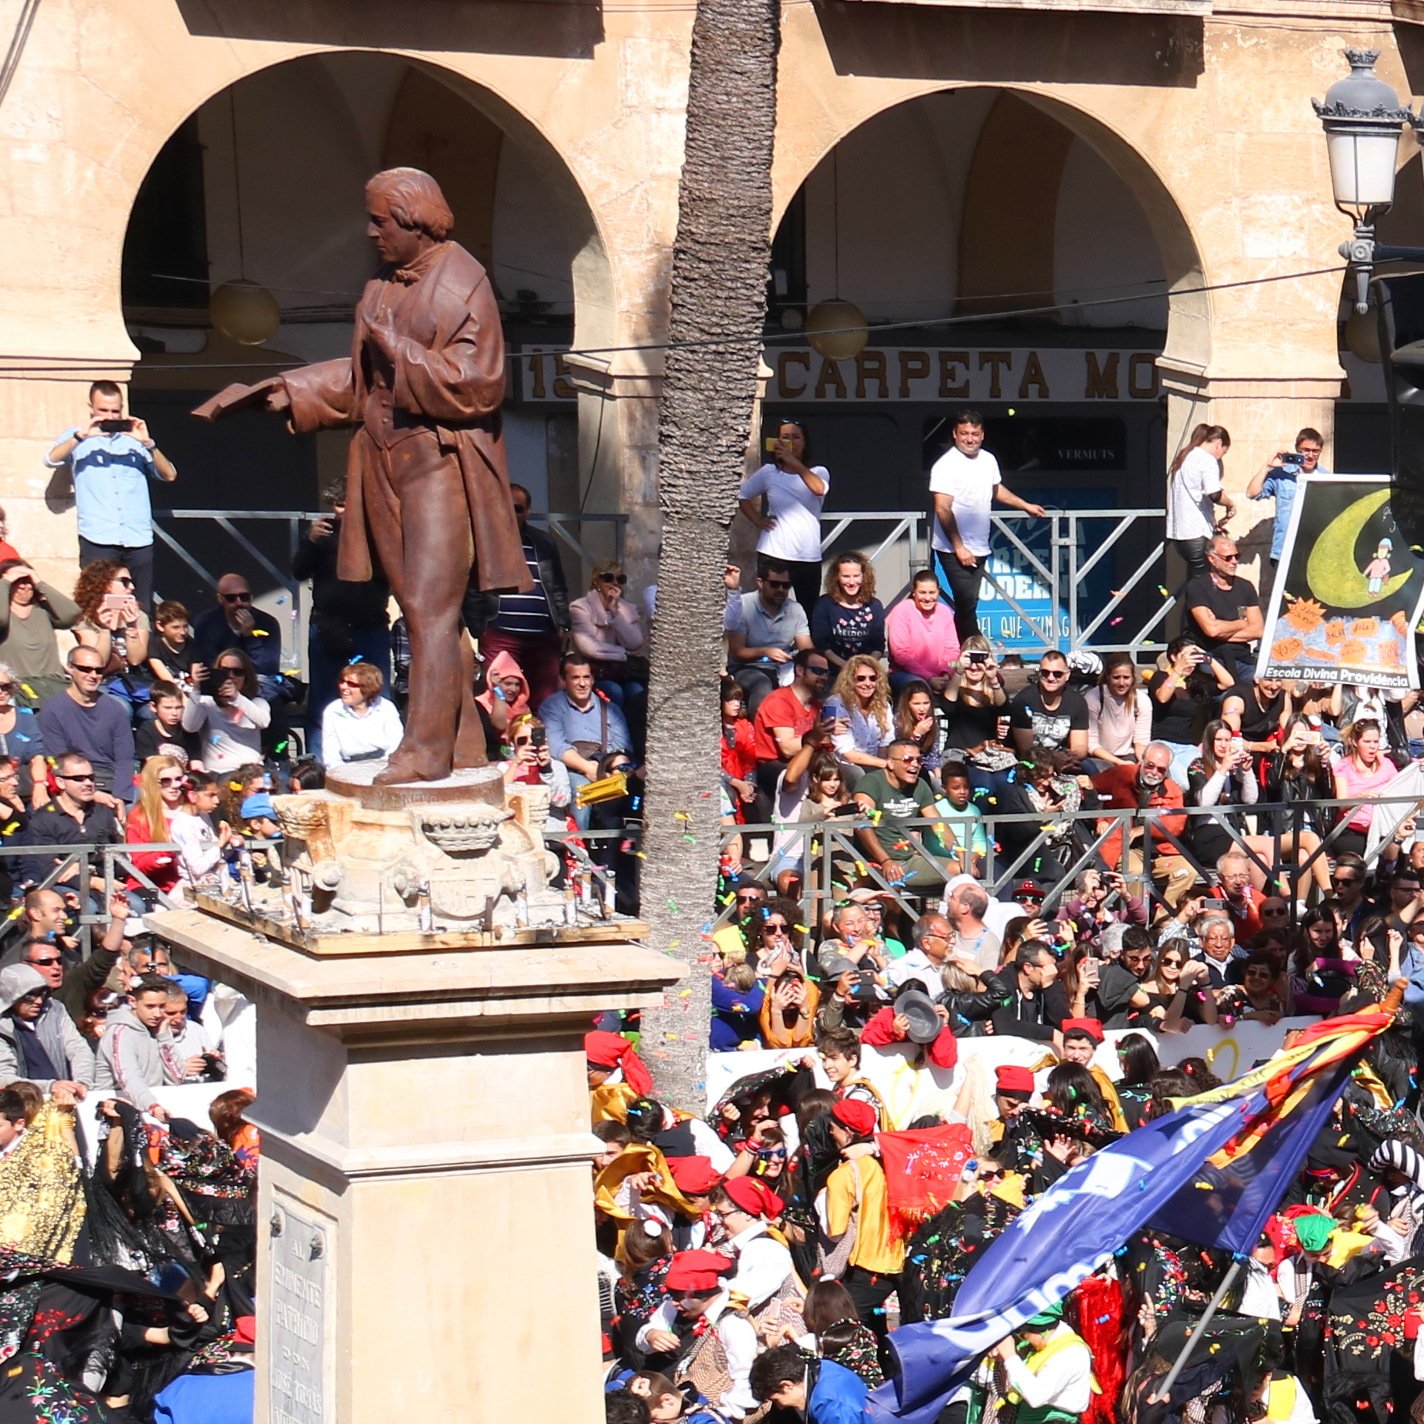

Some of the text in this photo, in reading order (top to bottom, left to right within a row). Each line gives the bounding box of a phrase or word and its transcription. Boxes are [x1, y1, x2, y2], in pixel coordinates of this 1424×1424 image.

[778, 349, 1052, 398] CARPETA
[1057, 448, 1115, 460] VERMUTS
[1265, 667, 1302, 680] Escola
[1303, 667, 1339, 681] Divina
